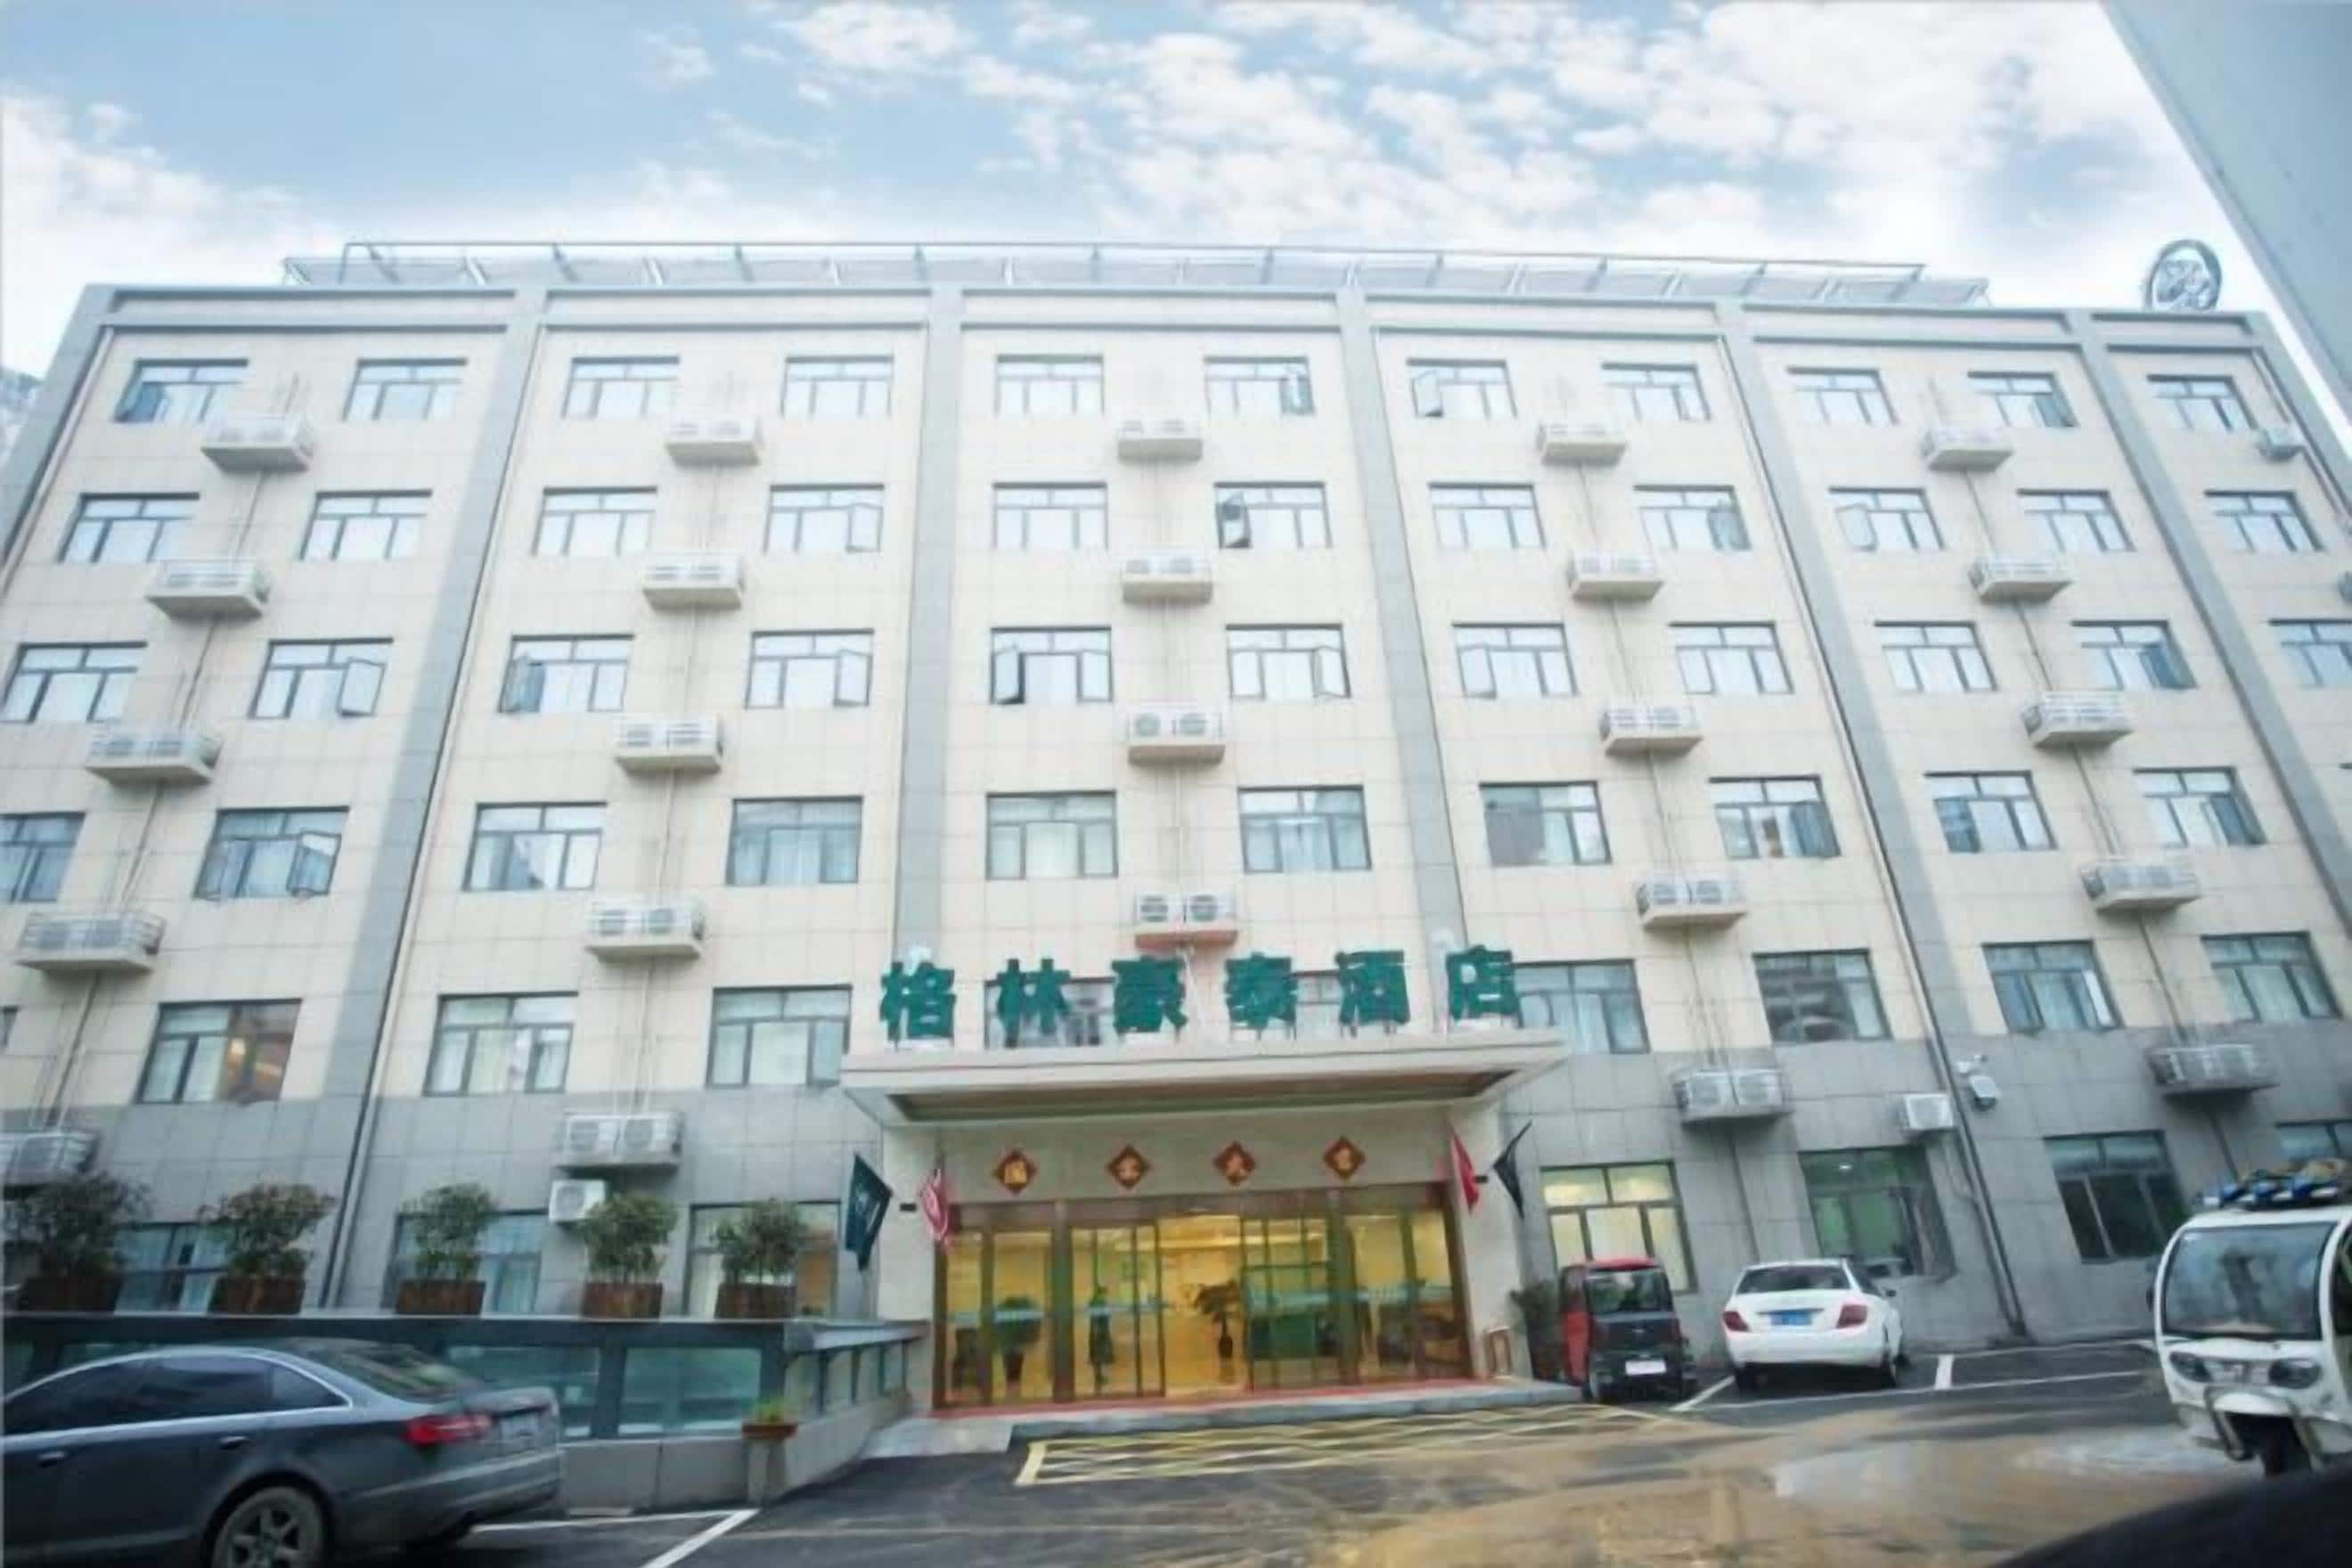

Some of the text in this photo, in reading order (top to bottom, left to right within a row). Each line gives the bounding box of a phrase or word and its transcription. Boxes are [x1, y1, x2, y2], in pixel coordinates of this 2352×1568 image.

[880, 945, 1514, 1049] 格林豪泰酒店
